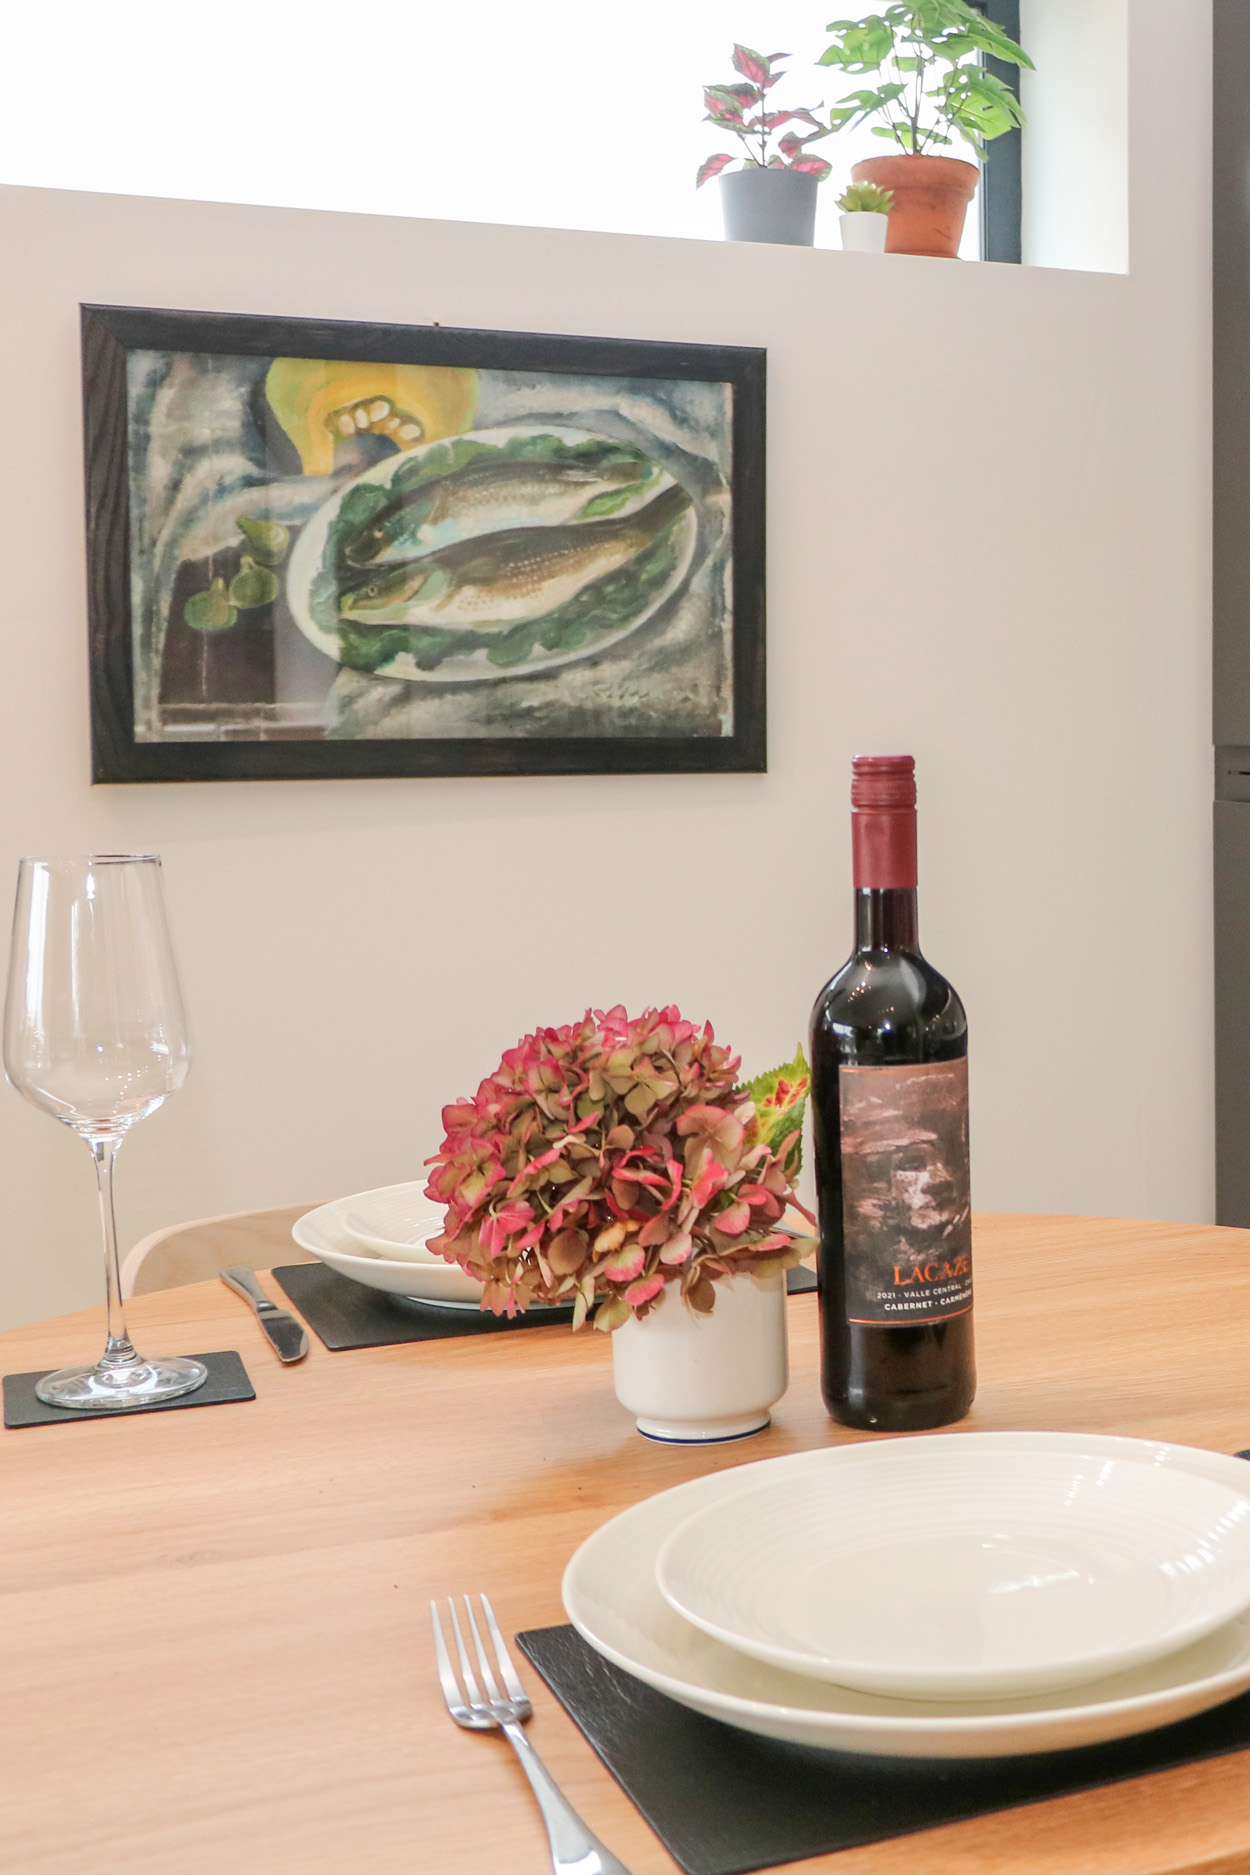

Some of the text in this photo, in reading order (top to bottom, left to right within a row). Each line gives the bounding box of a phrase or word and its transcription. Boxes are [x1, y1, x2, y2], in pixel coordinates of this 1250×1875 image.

[877, 1283, 961, 1299] 2021 VALLE CENTRAL
[884, 1300, 932, 1311] CABERNET
